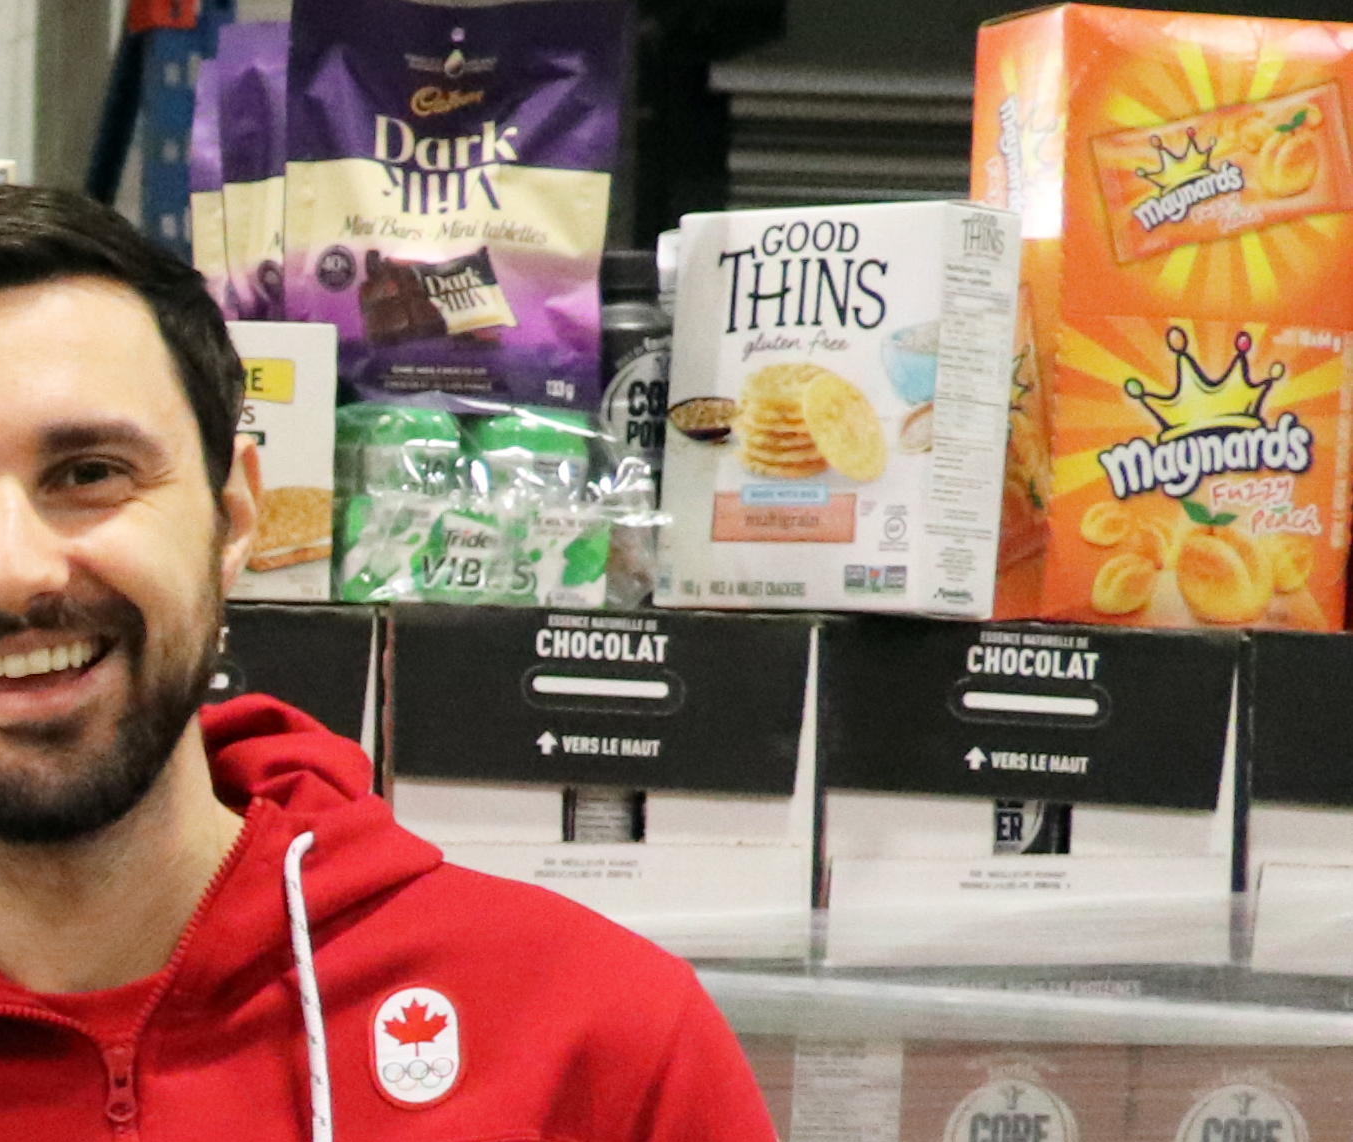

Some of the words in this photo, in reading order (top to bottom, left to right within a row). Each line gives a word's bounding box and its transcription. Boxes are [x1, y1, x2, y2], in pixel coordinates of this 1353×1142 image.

[375, 114, 519, 170] Dark
[761, 220, 860, 256] GOOD
[424, 266, 483, 297] Dark
[719, 245, 889, 335] THINS
[742, 328, 802, 362] gluten
[806, 331, 852, 354] free
[745, 510, 820, 530] multigrain
[444, 528, 492, 549] Tride
[420, 555, 538, 592] VIBS
[535, 629, 669, 662] CHOCOLAT
[966, 645, 1100, 680] CHOCOLAT
[561, 735, 599, 754] VERS
[602, 738, 619, 755] LE
[621, 739, 661, 758] HAUT
[991, 752, 1028, 770] VERS
[1030, 753, 1048, 771] LE
[1050, 755, 1089, 773] HAUT
